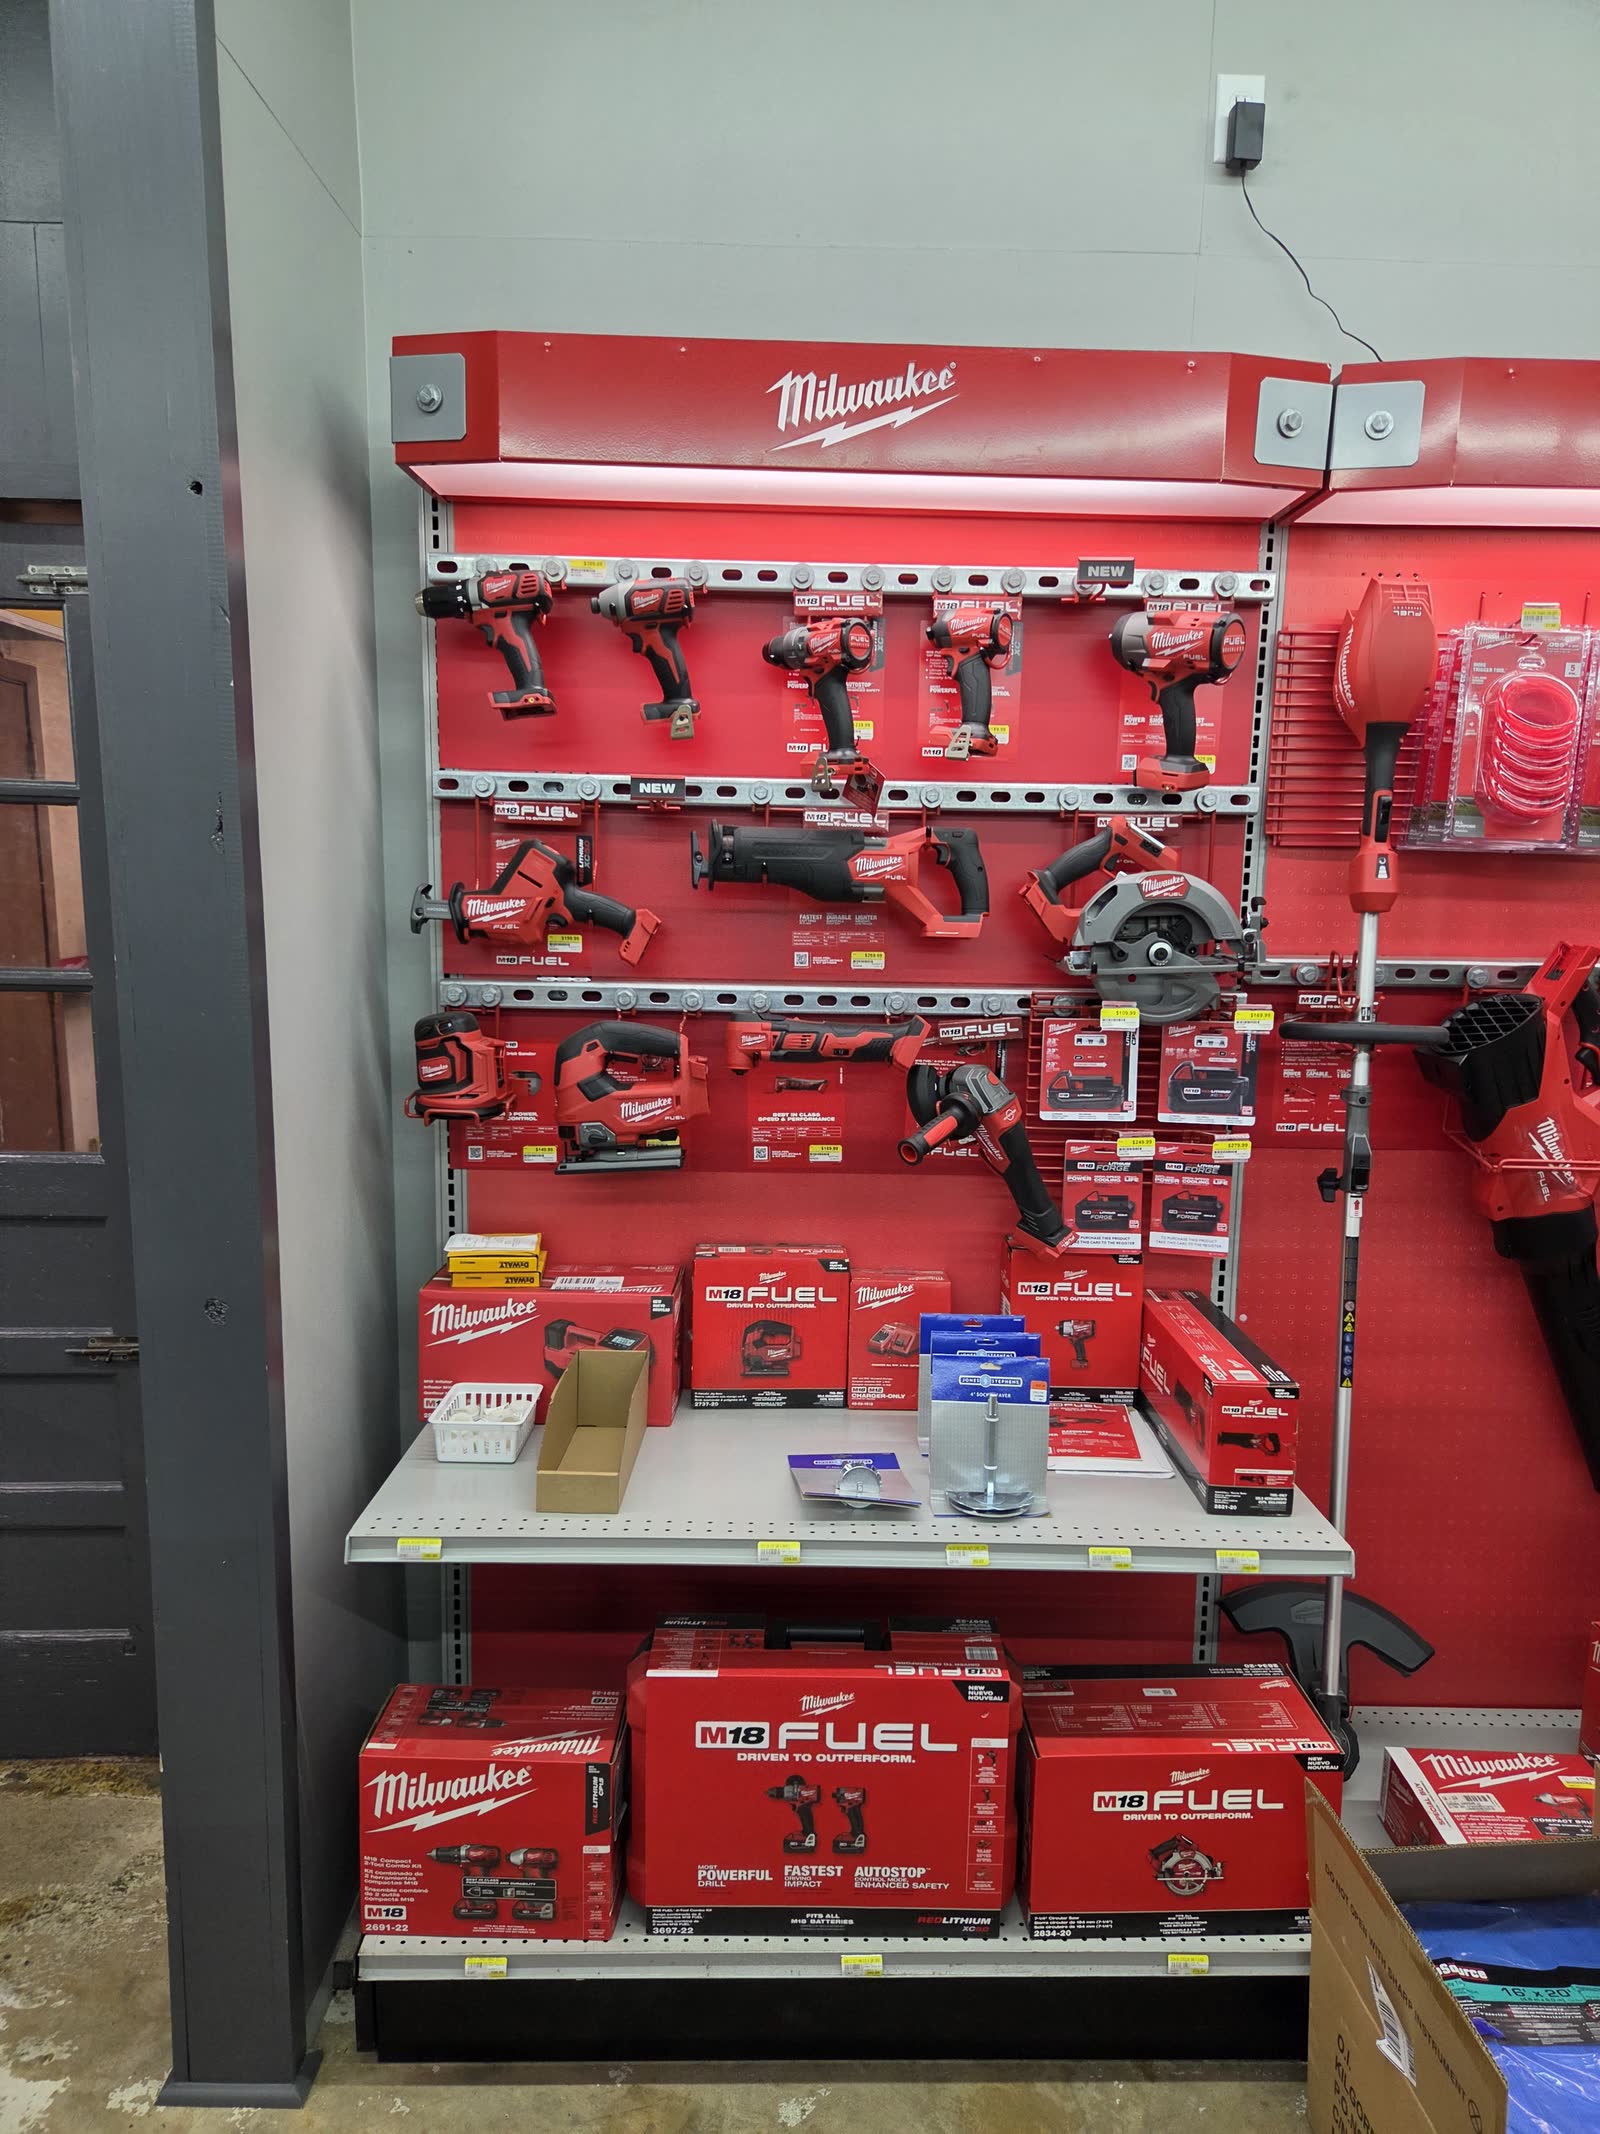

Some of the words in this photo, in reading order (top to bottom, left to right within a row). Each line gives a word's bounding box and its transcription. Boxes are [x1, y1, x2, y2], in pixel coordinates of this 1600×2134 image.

[766, 361, 953, 432] Milwaukee
[1087, 565, 1125, 577] NEW
[486, 577, 512, 592] Milwaukee
[634, 593, 659, 607] Milwaukee
[796, 597, 819, 606] M18
[822, 595, 879, 606] FUEL
[935, 600, 959, 610] M18
[1148, 602, 1171, 612] M18
[951, 616, 987, 631] Milwaukee
[1151, 630, 1204, 649] Milwaukee
[1224, 637, 1246, 645] FUEL
[1341, 623, 1355, 708] Milwaukee
[788, 743, 808, 752] M18
[922, 747, 943, 757] M18
[639, 782, 676, 794] NEW
[495, 804, 519, 815] M18
[521, 805, 578, 818] FUEL
[805, 811, 828, 821] M18
[855, 856, 902, 872] Milwaukee
[1141, 876, 1185, 892] Milwaukee
[467, 898, 527, 916] Milwaukee
[496, 956, 517, 965] M18
[519, 956, 570, 966] FUEL
[1299, 994, 1322, 1004] M18
[941, 1027, 962, 1037] M18
[964, 1022, 1019, 1036] FUEL
[741, 1034, 766, 1043] Milwaukee
[421, 1064, 448, 1075] Milwaukee
[620, 1097, 672, 1119] Milwaukee
[1276, 1123, 1296, 1132] M18
[1298, 1123, 1345, 1132] FUEL
[978, 1124, 1004, 1160] Milwaukee
[929, 1147, 979, 1157] FUEL
[1537, 1171, 1551, 1202] FUEL
[759, 1271, 787, 1281] Milwaukee
[706, 1287, 743, 1301] M18
[747, 1286, 837, 1302] FUEL
[855, 1282, 913, 1305] Milwaukee
[1019, 1282, 1050, 1294] M18
[1054, 1282, 1133, 1297] FUEL
[424, 1298, 537, 1336] Milwaukee
[1222, 1406, 1241, 1414] M18
[1243, 1406, 1289, 1416] FUEL
[874, 1664, 962, 1677] FUEL
[965, 1666, 1002, 1677] M18
[800, 1691, 856, 1712] Milwaukee
[698, 1723, 767, 1746] M18
[778, 1722, 958, 1752] FUEL
[491, 1736, 606, 1758] Milwaukee
[1212, 1741, 1297, 1752] FUEL
[1299, 1742, 1334, 1751] M18
[737, 1752, 789, 1762] DRIVEN
[793, 1752, 812, 1762] TO
[816, 1753, 916, 1764] OUTPERFORM.
[1420, 1753, 1560, 1779] Milwaukee
[1169, 1768, 1210, 1783] Milwaukee
[363, 1763, 533, 1819] Milwaukee
[1413, 1782, 1426, 1797] BUY
[1094, 1792, 1148, 1810] M18
[1153, 1789, 1284, 1812] FUEL
[1123, 1813, 1162, 1821] DRIVEN
[1164, 1813, 1178, 1821] TO
[1180, 1812, 1254, 1821] OUTPERFORM.
[1424, 1799, 1445, 1826] SPECIAL
[697, 1869, 773, 1881] POWERFUL
[784, 1865, 843, 1877] FASTEST
[854, 1866, 927, 1878] AUTOSTOP
[364, 1878, 402, 1886] compactas
[784, 1880, 822, 1888] IMPACT
[854, 1881, 910, 1889] ENHANCED
[912, 1882, 950, 1890] SAFETY
[365, 1906, 405, 1919] M18
[918, 1916, 991, 1925] REDLITHIUM
[365, 1923, 409, 1932] 2691-22
[652, 1927, 694, 1935] 3697-22
[1033, 1929, 1072, 1937] 2834-20
[1324, 1863, 1335, 1884] DO
[1335, 1881, 1349, 1905] NOT
[1350, 1901, 1368, 1938] OPEN
[1369, 1937, 1387, 1972] WITH
[1387, 1966, 1413, 2011] SHARP
[1413, 2009, 1467, 2101] INSTRUMENT
[1501, 1987, 1526, 1997] 16'
[1546, 1988, 1571, 1998] 20'
